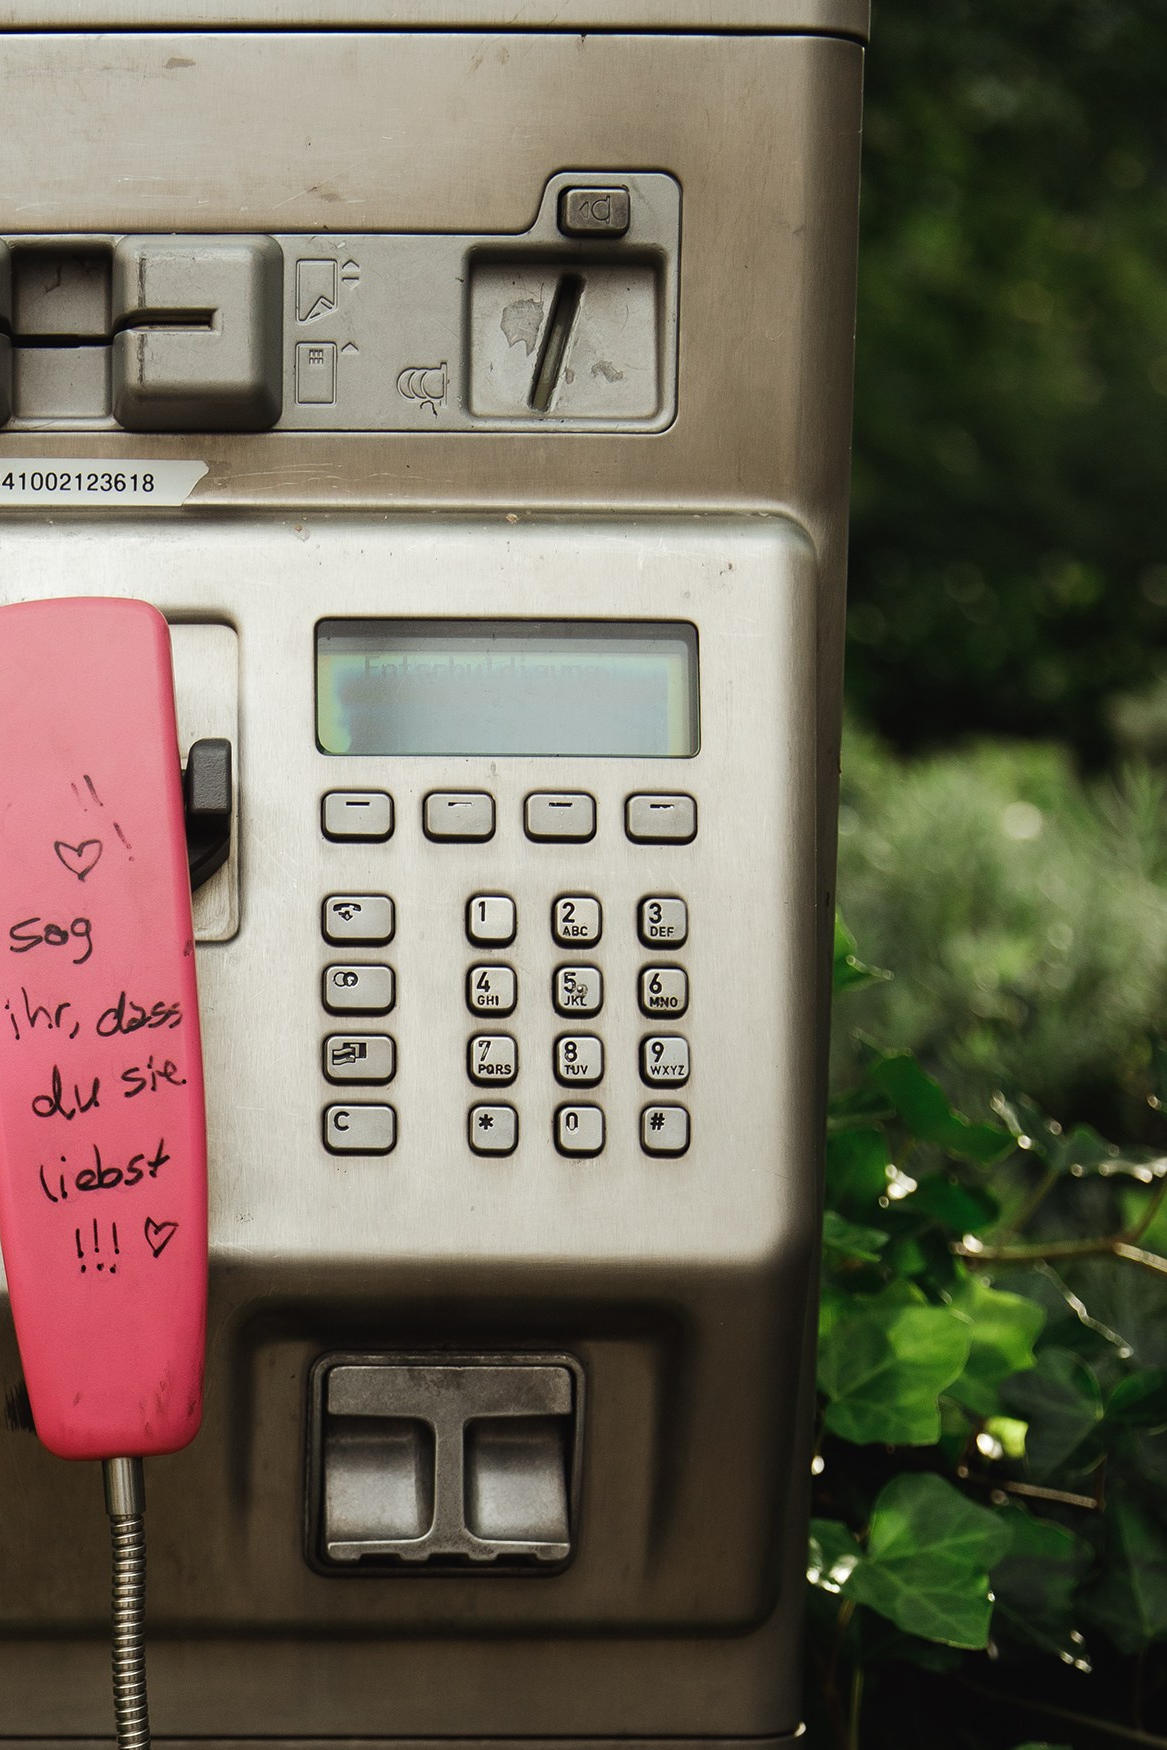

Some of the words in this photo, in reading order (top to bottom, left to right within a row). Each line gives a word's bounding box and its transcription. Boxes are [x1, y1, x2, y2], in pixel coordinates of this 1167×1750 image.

[478, 901, 487, 922] 1
[562, 902, 576, 924] 2
[649, 903, 663, 924] 3
[562, 925, 588, 937] ABC
[650, 926, 675, 938] DEF
[477, 972, 491, 993] 4
[563, 972, 577, 994] 5
[649, 973, 662, 994] 6
[477, 995, 500, 1006] GHI
[564, 995, 587, 1007] JKL
[650, 996, 678, 1008] MNO
[4, 987, 80, 1040] ihr,
[96, 990, 183, 1038] dass
[478, 1041, 492, 1062] 7
[564, 1042, 578, 1063] 8
[651, 1042, 664, 1064] 9
[478, 1064, 512, 1076] PQRS
[564, 1065, 588, 1076] TUV
[650, 1065, 685, 1076] WXYZ
[31, 1065, 101, 1121] du
[334, 1111, 350, 1131] C
[39, 1138, 171, 1203] liebst
